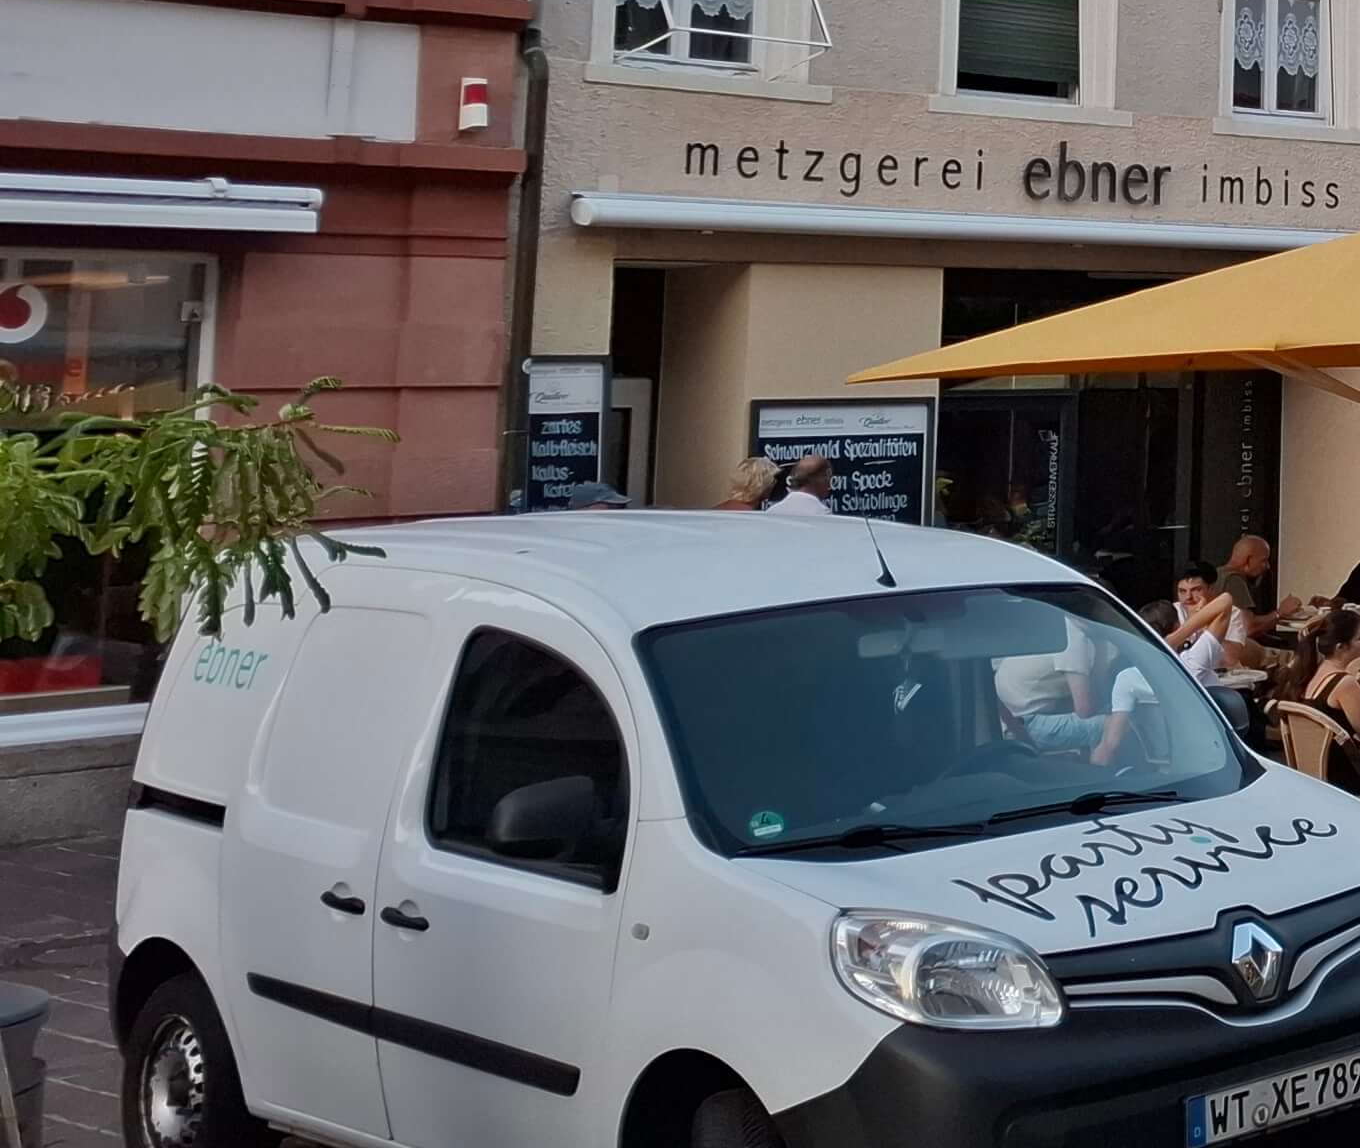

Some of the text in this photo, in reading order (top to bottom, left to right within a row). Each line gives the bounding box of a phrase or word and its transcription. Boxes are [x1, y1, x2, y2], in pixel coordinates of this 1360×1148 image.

[684, 139, 1341, 210] metzgerei ebner imbiss
[764, 437, 918, 462] Schwarzwald Spezialitäten
[851, 470, 895, 493] Speck
[194, 637, 269, 690] ebner
[951, 817, 1240, 921] party
[1075, 818, 1338, 939] service
[1209, 1090, 1250, 1136] WT
